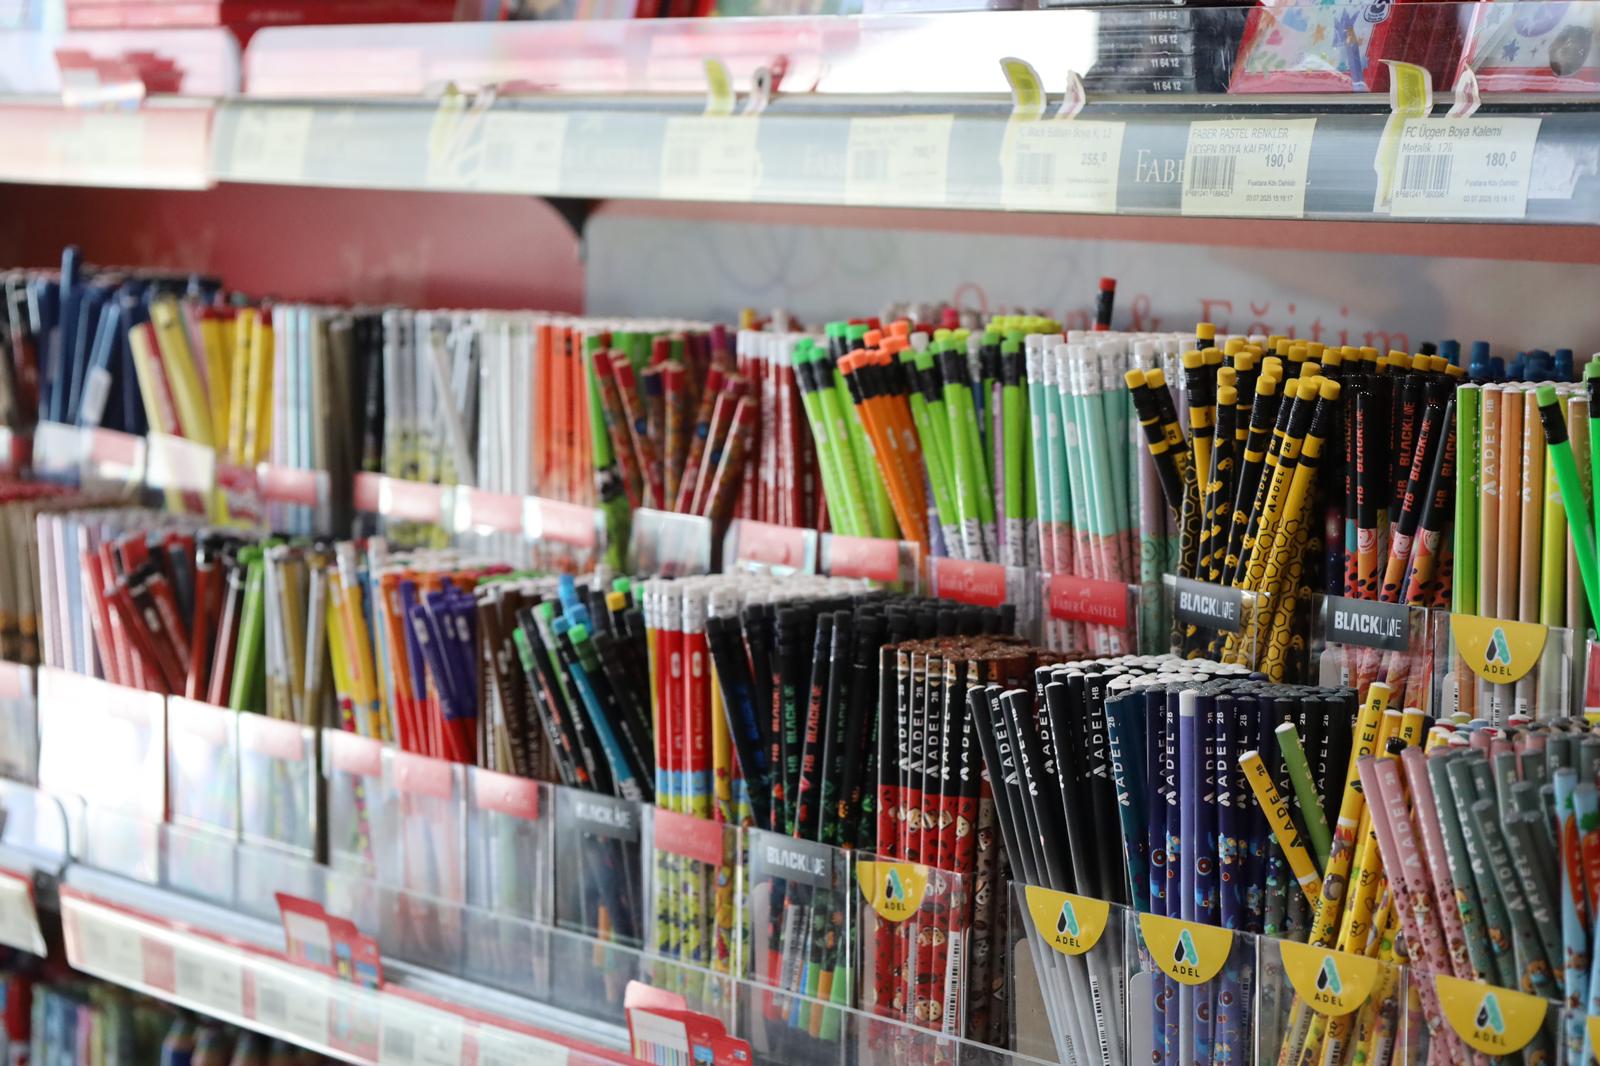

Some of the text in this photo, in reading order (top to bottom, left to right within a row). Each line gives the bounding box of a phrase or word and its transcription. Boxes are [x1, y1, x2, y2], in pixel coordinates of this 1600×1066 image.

[1220, 128, 1249, 139] PASTEL
[1251, 127, 1289, 138] RENKLER
[1405, 124, 1503, 140] FC Üçgen Boya Kalemi
[1271, 442, 1292, 504] ADEL 2B
[1485, 422, 1495, 475] ADEL
[1402, 492, 1415, 512] HB
[1179, 591, 1235, 620] BLACKLINE
[1334, 610, 1402, 638] BLACKLINE
[1483, 664, 1512, 676] ADEL
[898, 704, 907, 753] ADEL
[913, 686, 924, 755] ADEL 2B
[928, 691, 939, 760] ADEL 2B
[961, 712, 971, 763] ADEL
[991, 697, 1014, 767] ADEL HB
[1037, 683, 1051, 755] ADEL HB
[1092, 686, 1104, 760] ADEL HB
[1359, 699, 1381, 756] DEL 2B
[1404, 726, 1413, 738] 2B
[1016, 727, 1032, 778] ADEL
[1108, 716, 1126, 788] ADEL 2B
[1166, 711, 1175, 786] ADEL 2B
[1216, 711, 1227, 787] ADEL 2B
[1318, 735, 1329, 790] ADEL
[1256, 763, 1295, 831] ADEL 2B
[1391, 797, 1415, 848] ADEL
[766, 846, 826, 876] BLACKLINE
[884, 902, 907, 911] ADEL
[1055, 934, 1081, 948] ADEL
[1172, 964, 1200, 978] ADEL
[1314, 993, 1344, 1007] ADEL
[1473, 1030, 1507, 1046] ADEL
